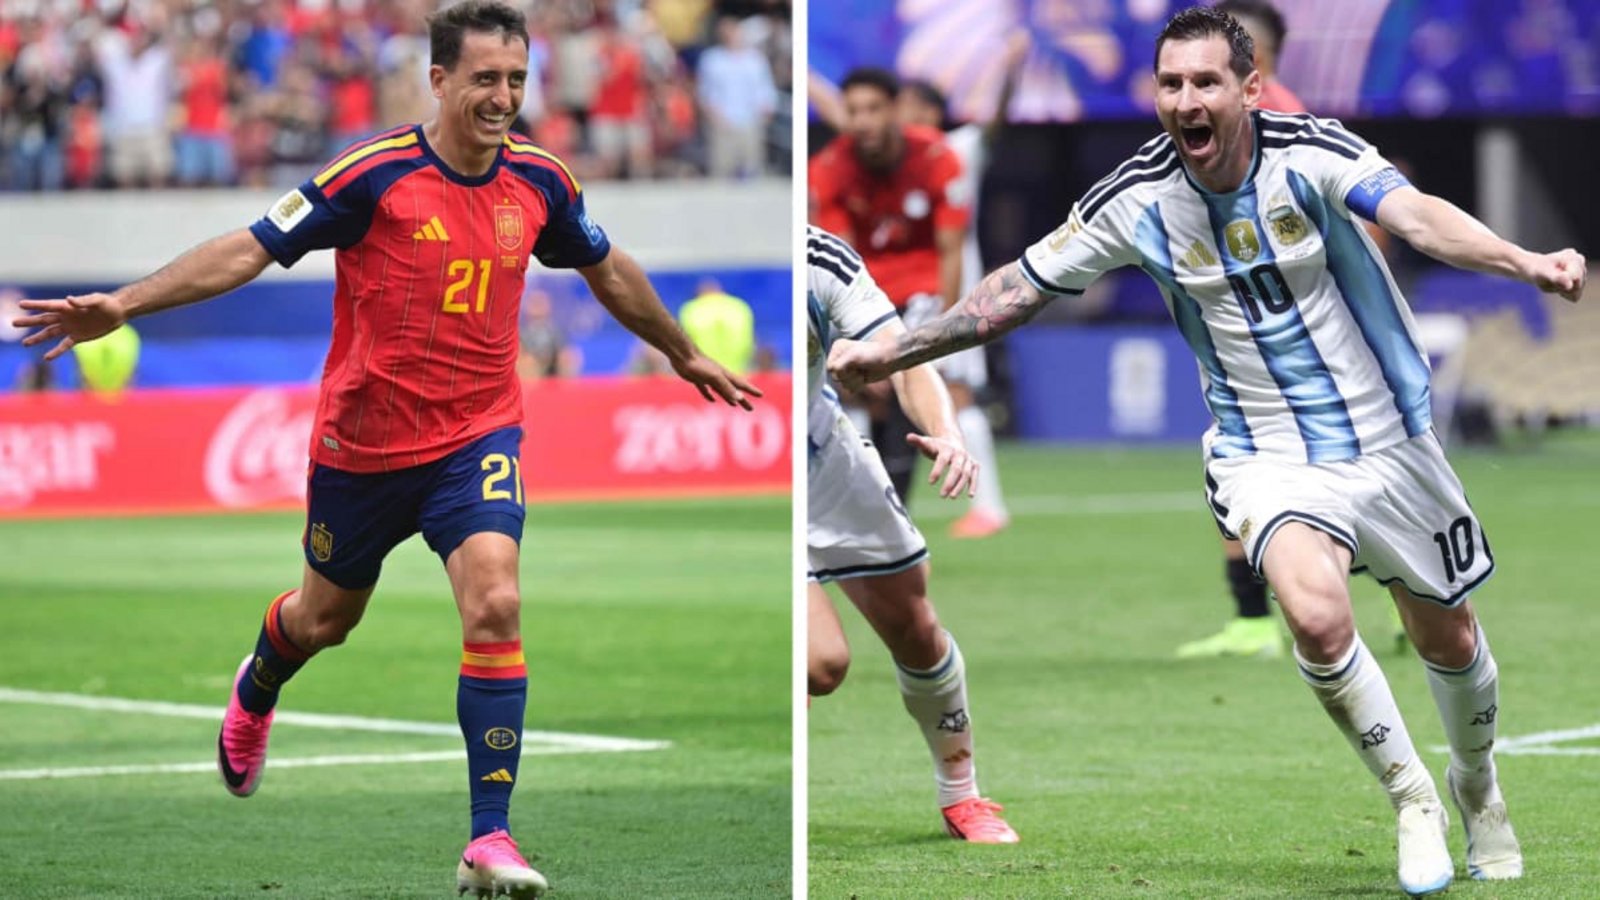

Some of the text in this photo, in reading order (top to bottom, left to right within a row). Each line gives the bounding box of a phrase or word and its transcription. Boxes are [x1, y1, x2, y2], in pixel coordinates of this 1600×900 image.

[442, 259, 491, 313] 21
[1227, 263, 1295, 324] 10
[612, 402, 786, 474] zero
[481, 453, 523, 505] 21
[1433, 516, 1475, 583] 10
